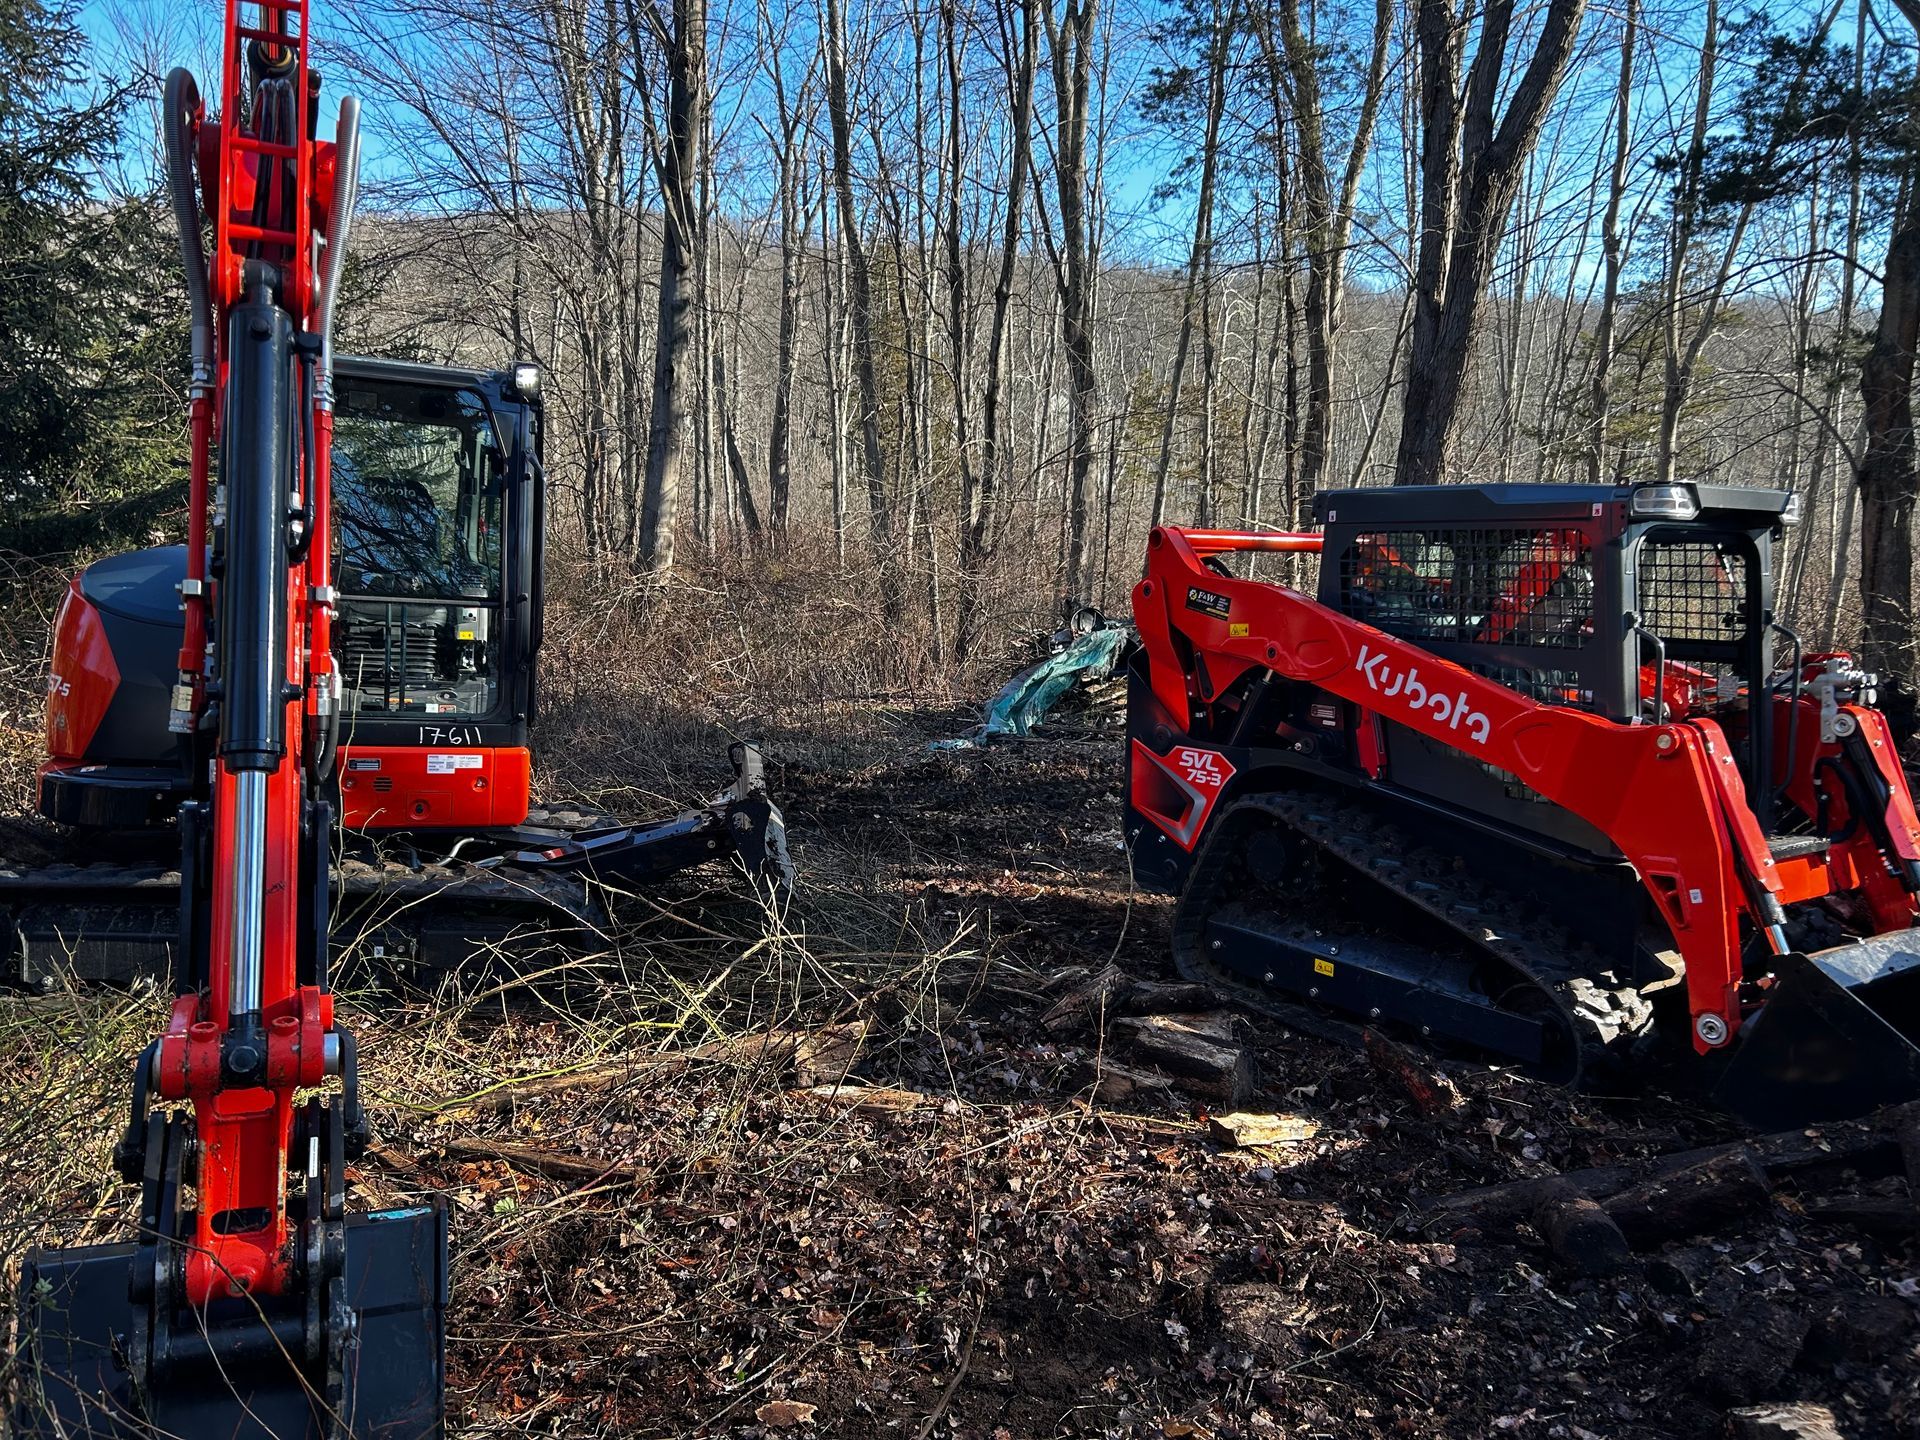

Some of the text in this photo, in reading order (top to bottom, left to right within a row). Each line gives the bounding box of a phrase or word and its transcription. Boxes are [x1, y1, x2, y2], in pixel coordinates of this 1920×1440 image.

[368, 481, 417, 499] Kubota
[1355, 644, 1491, 745] Kubota
[419, 726, 482, 745] 17611
[1178, 750, 1219, 772] SVL
[1186, 768, 1222, 787] 75-3
